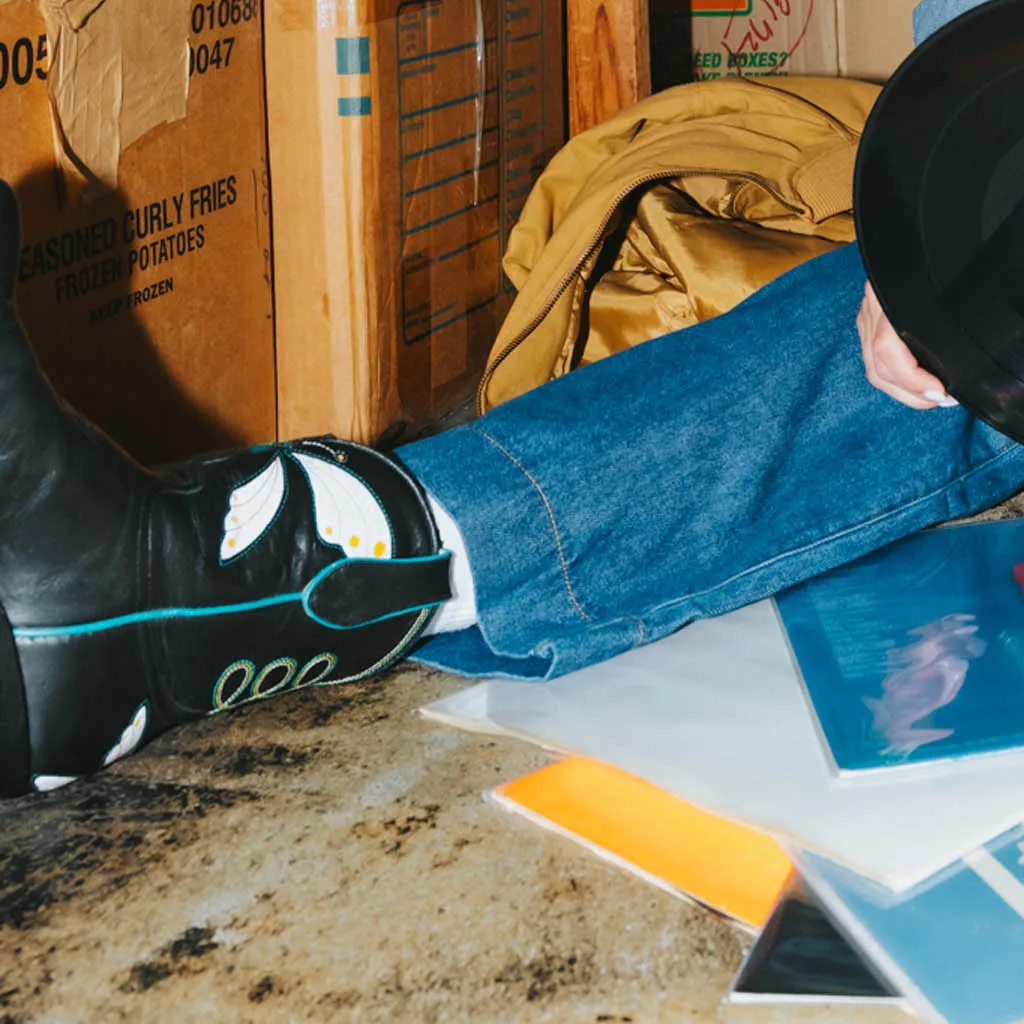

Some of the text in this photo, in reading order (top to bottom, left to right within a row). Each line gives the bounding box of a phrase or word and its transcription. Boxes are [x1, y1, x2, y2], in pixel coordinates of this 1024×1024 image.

[690, 51, 789, 68] EED BOXES?
[17, 175, 238, 282] EASONED CURLY FRIES
[55, 224, 206, 304] FROZEN POTATOES
[127, 277, 174, 308] FROZEN
